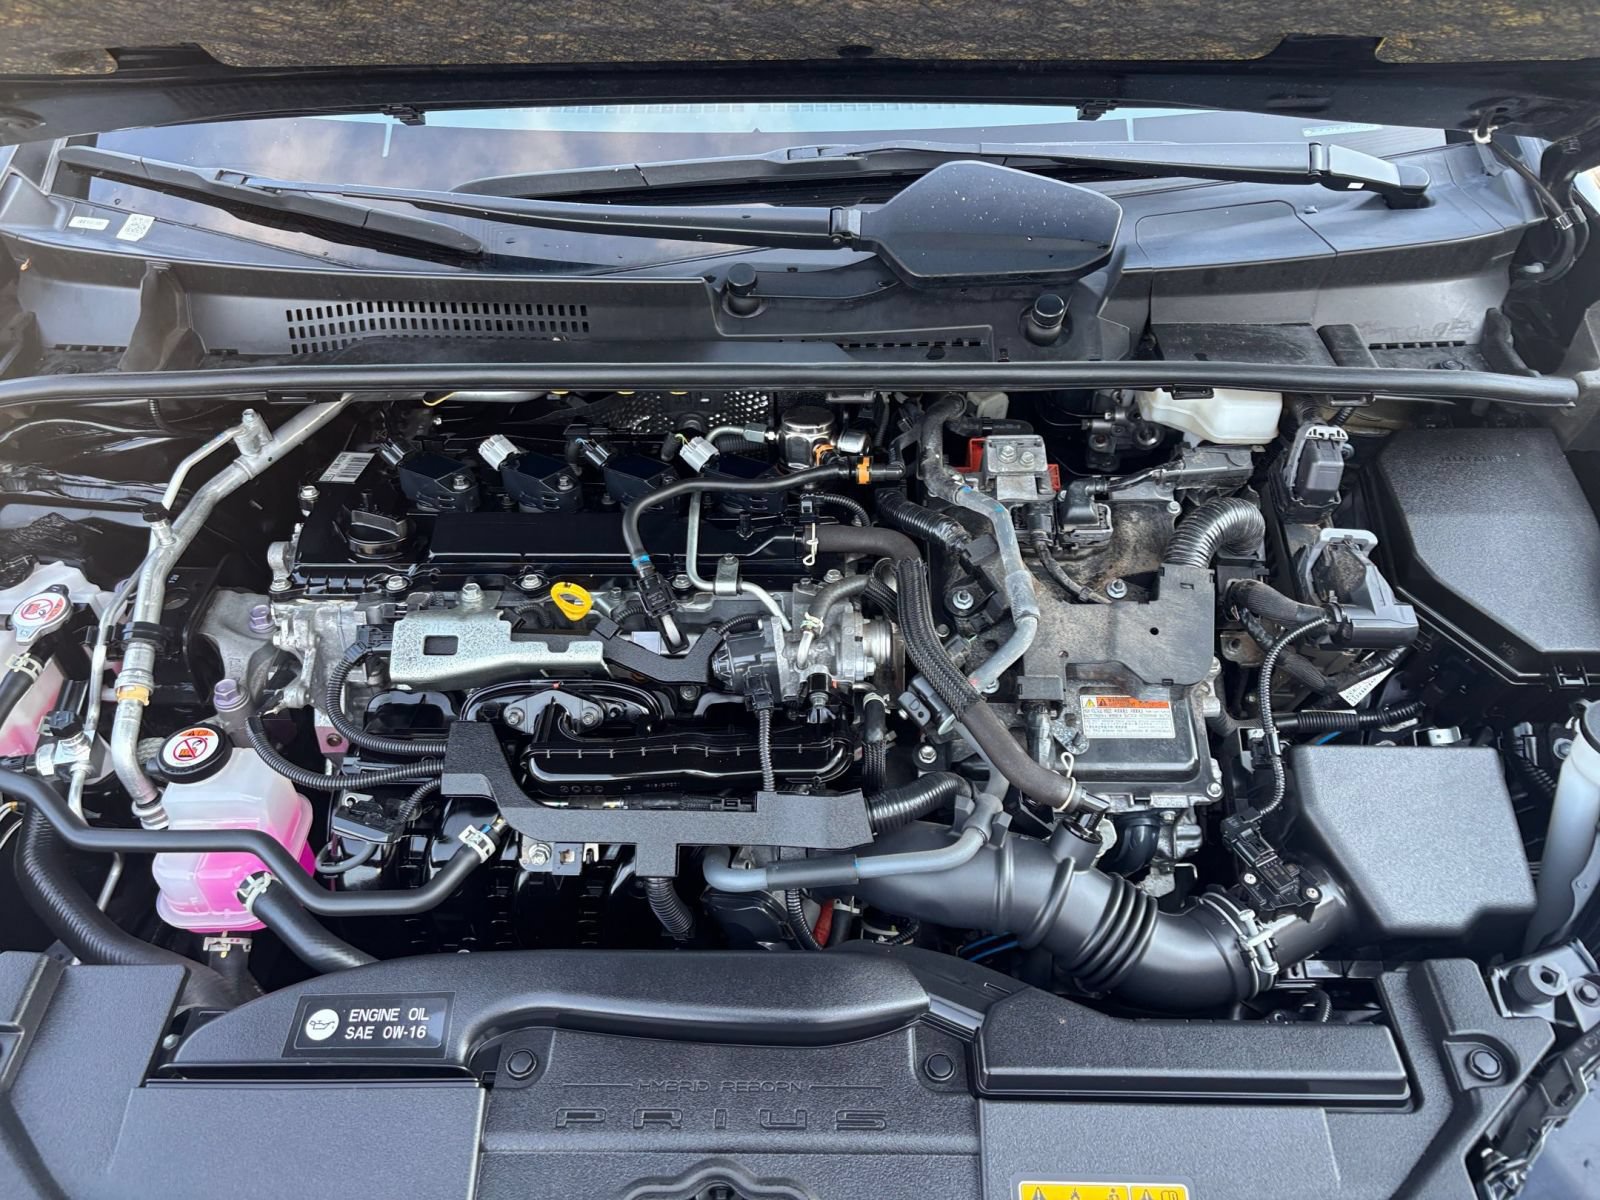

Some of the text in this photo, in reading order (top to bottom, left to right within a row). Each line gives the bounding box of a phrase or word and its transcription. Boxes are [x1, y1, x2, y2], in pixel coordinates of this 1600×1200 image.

[348, 1007, 430, 1022] ENGINE OIL
[344, 1025, 427, 1040] SAE 0W-16
[637, 1080, 802, 1093] HYBRID REBORN
[554, 1107, 888, 1131] PRIUS
